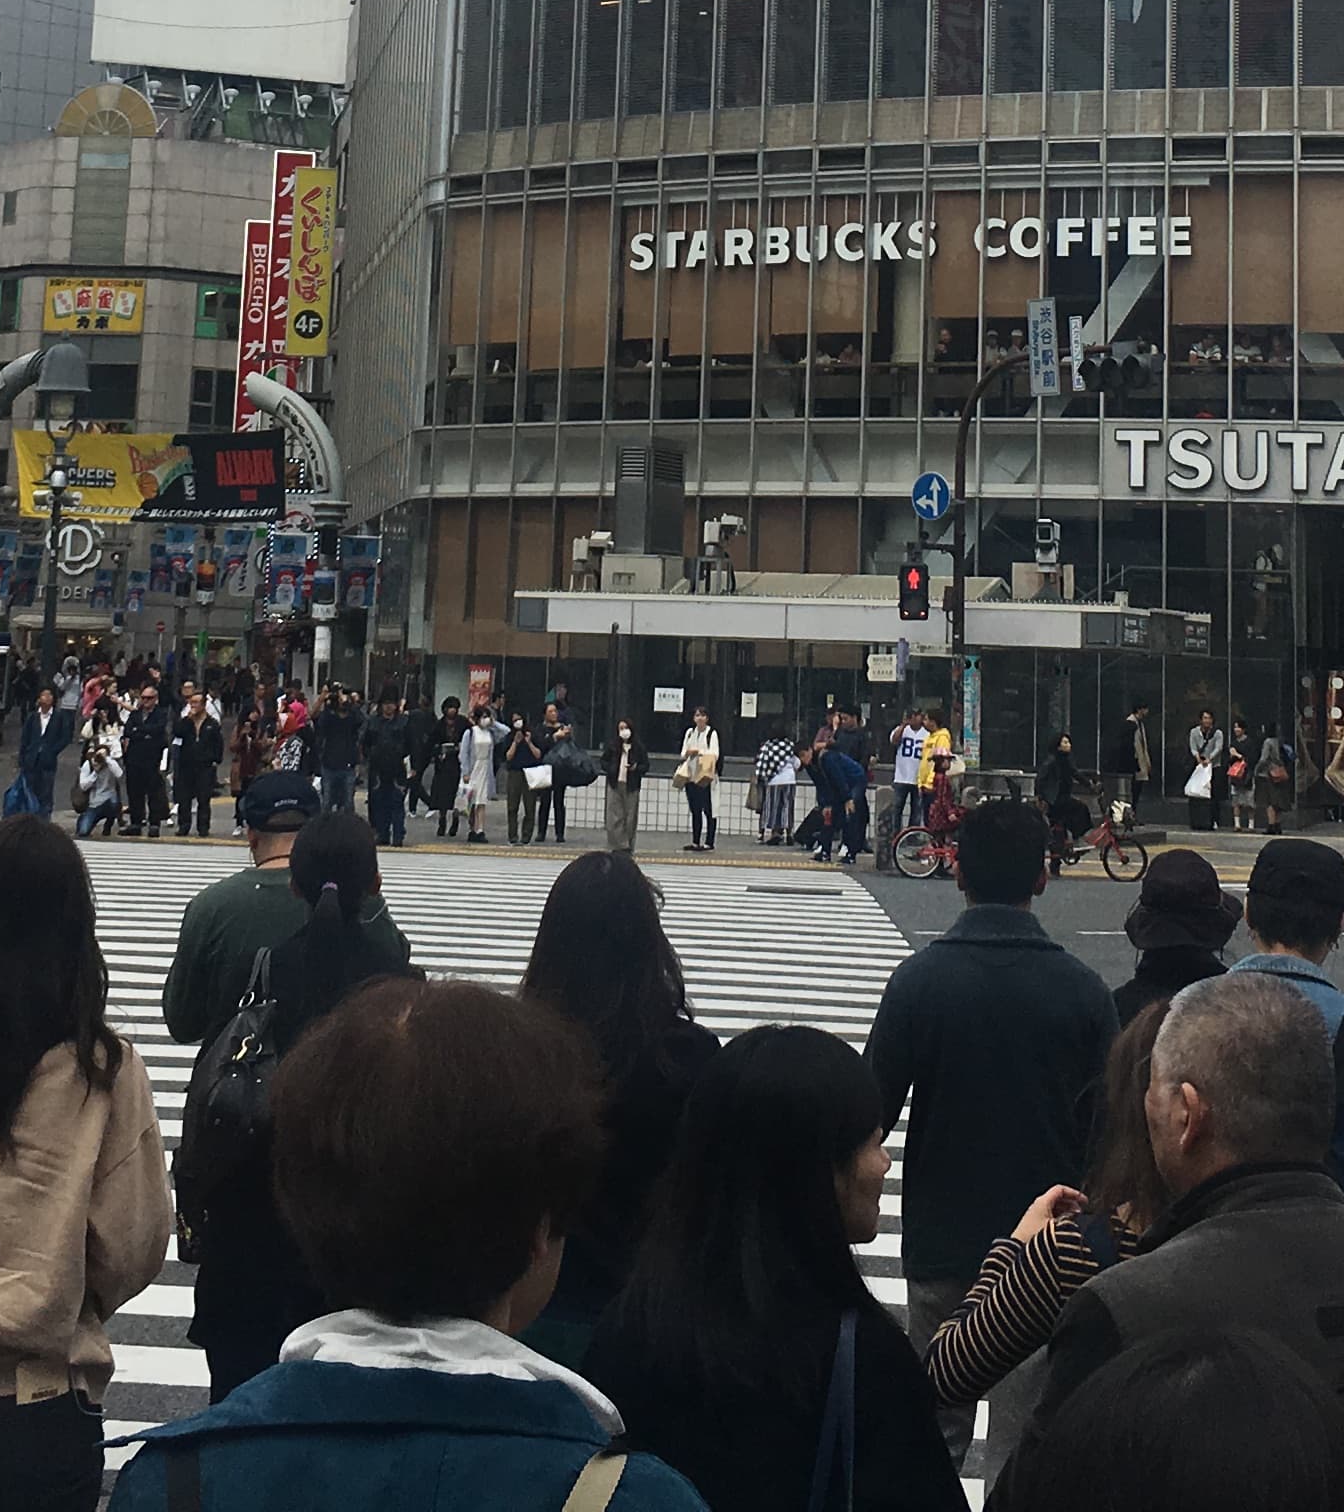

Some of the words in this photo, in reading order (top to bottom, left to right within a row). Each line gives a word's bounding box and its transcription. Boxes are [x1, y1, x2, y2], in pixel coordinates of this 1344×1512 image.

[629, 221, 936, 271] STARBUCKS
[974, 215, 1192, 258] COFFEE
[295, 314, 320, 333] 4F
[1040, 307, 1055, 387] 渋谷駅前
